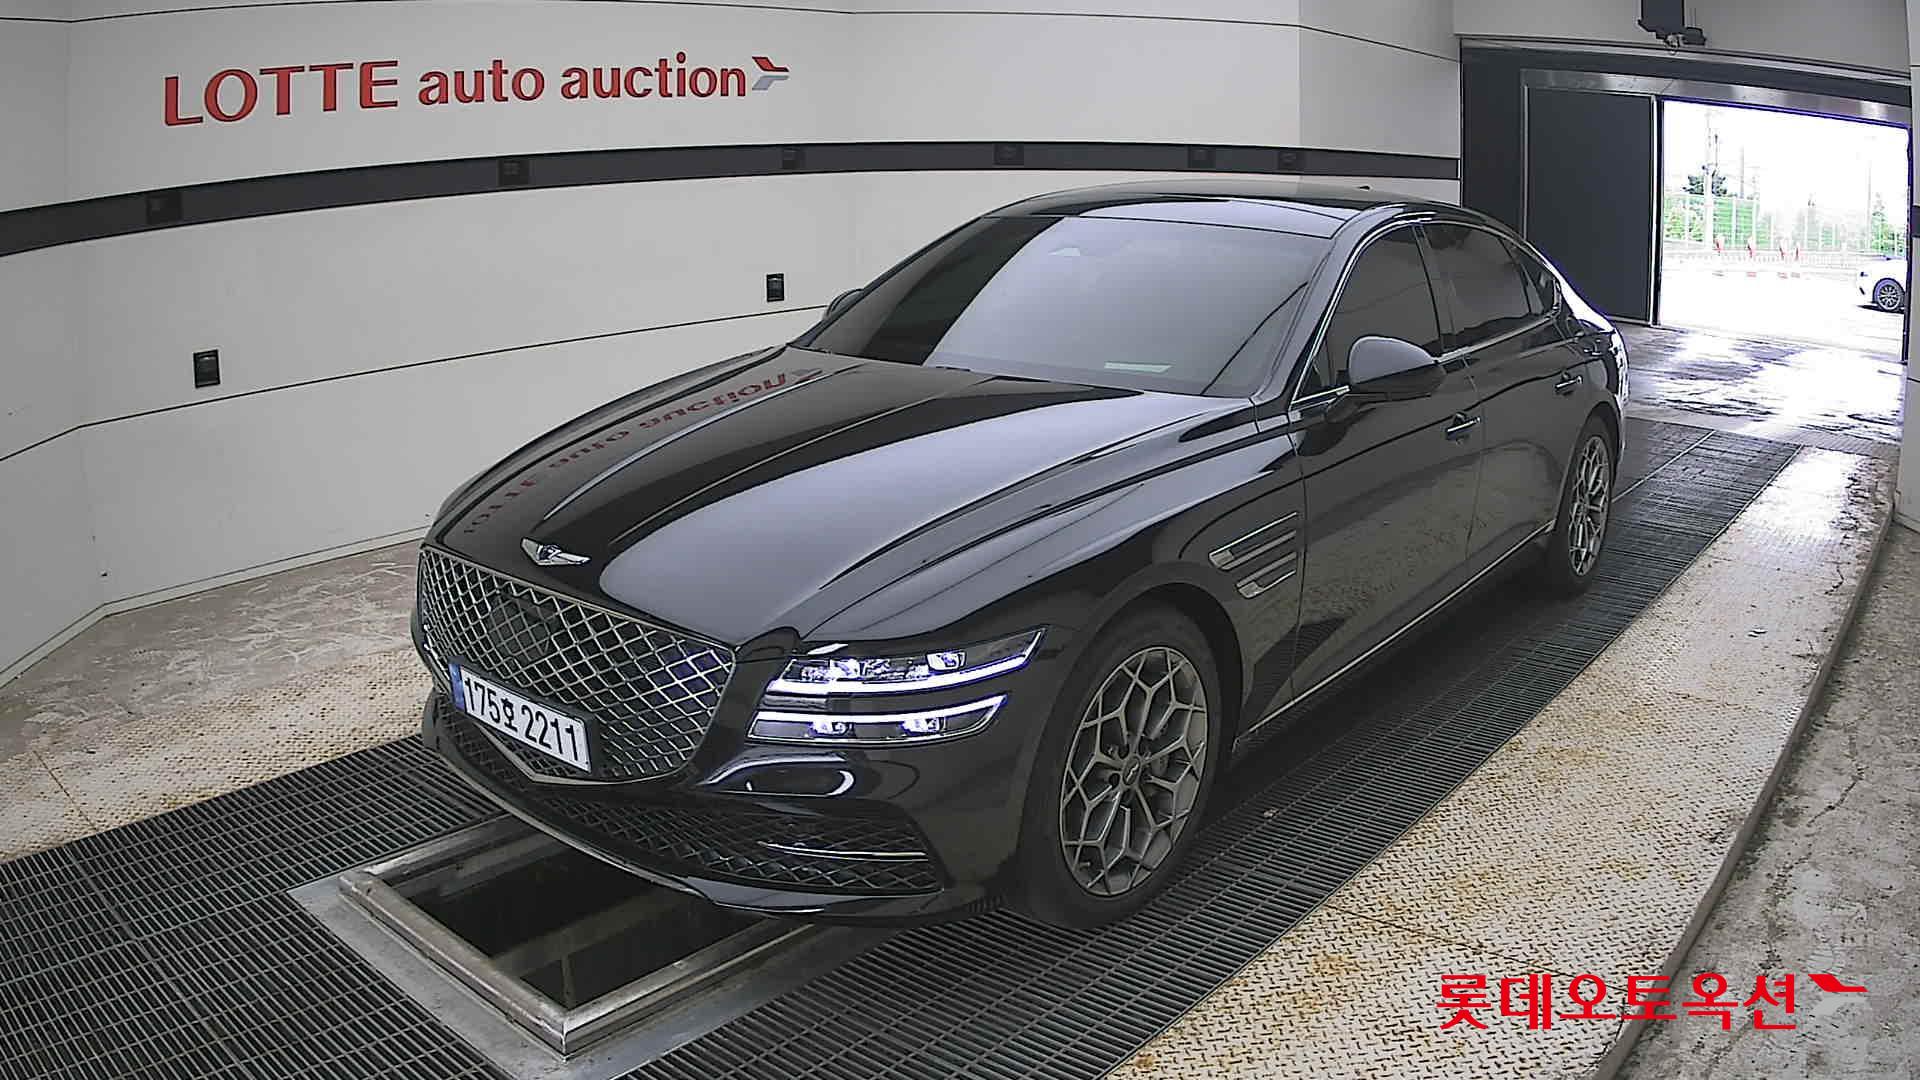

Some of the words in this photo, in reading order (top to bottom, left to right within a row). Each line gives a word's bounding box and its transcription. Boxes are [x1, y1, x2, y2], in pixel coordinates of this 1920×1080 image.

[164, 59, 399, 127] LOTTE
[418, 59, 545, 106] auto
[560, 51, 747, 100] auction
[464, 677, 518, 732] 175호
[521, 704, 579, 762] 2211
